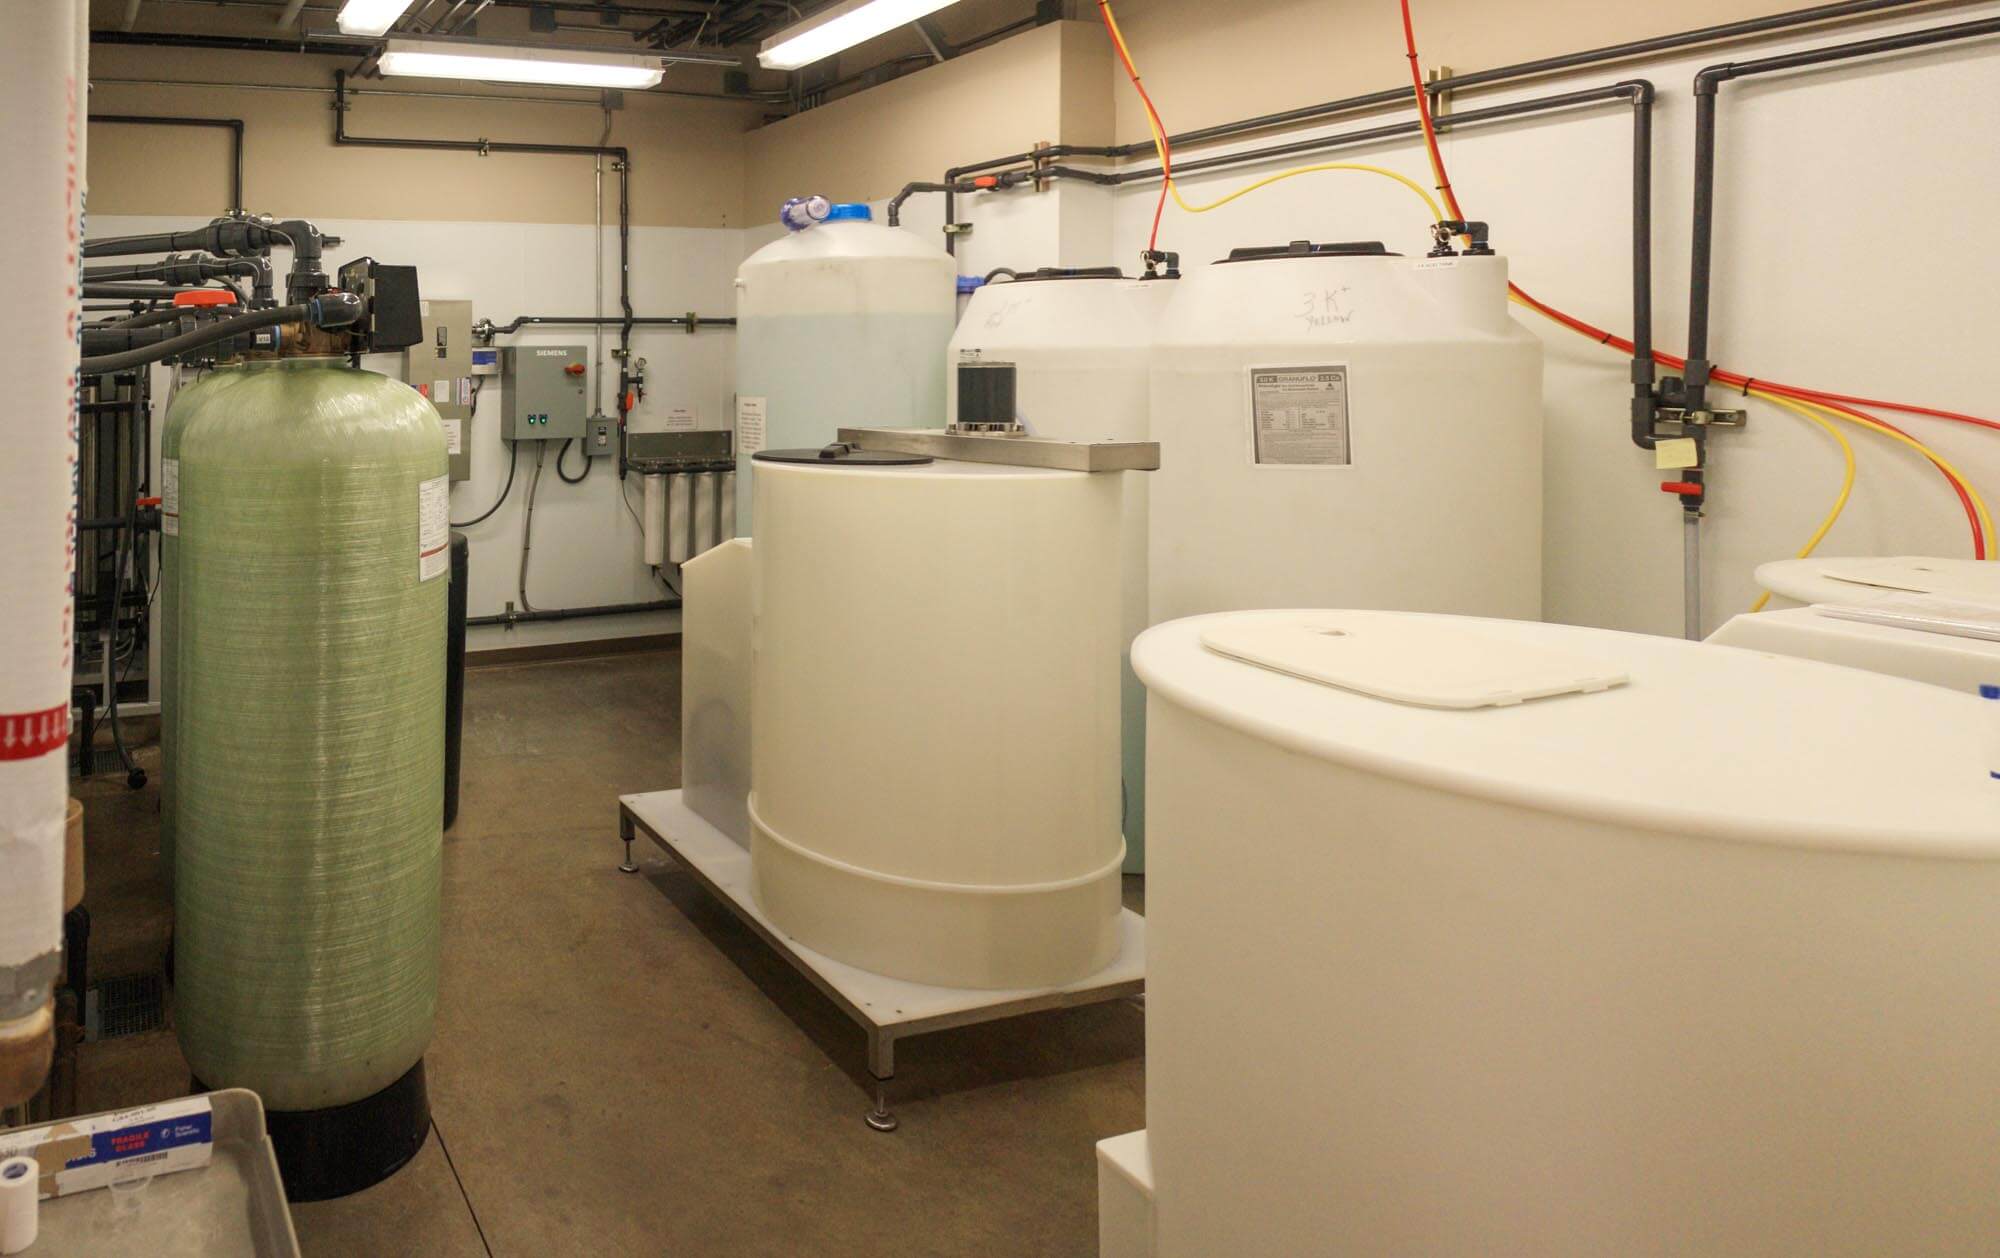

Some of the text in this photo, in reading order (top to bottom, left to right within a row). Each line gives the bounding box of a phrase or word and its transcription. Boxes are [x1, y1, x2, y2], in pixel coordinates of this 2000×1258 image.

[536, 349, 568, 357] SIEMENS
[111, 1130, 150, 1145] FRAGILE
[115, 1140, 145, 1153] GLASS
